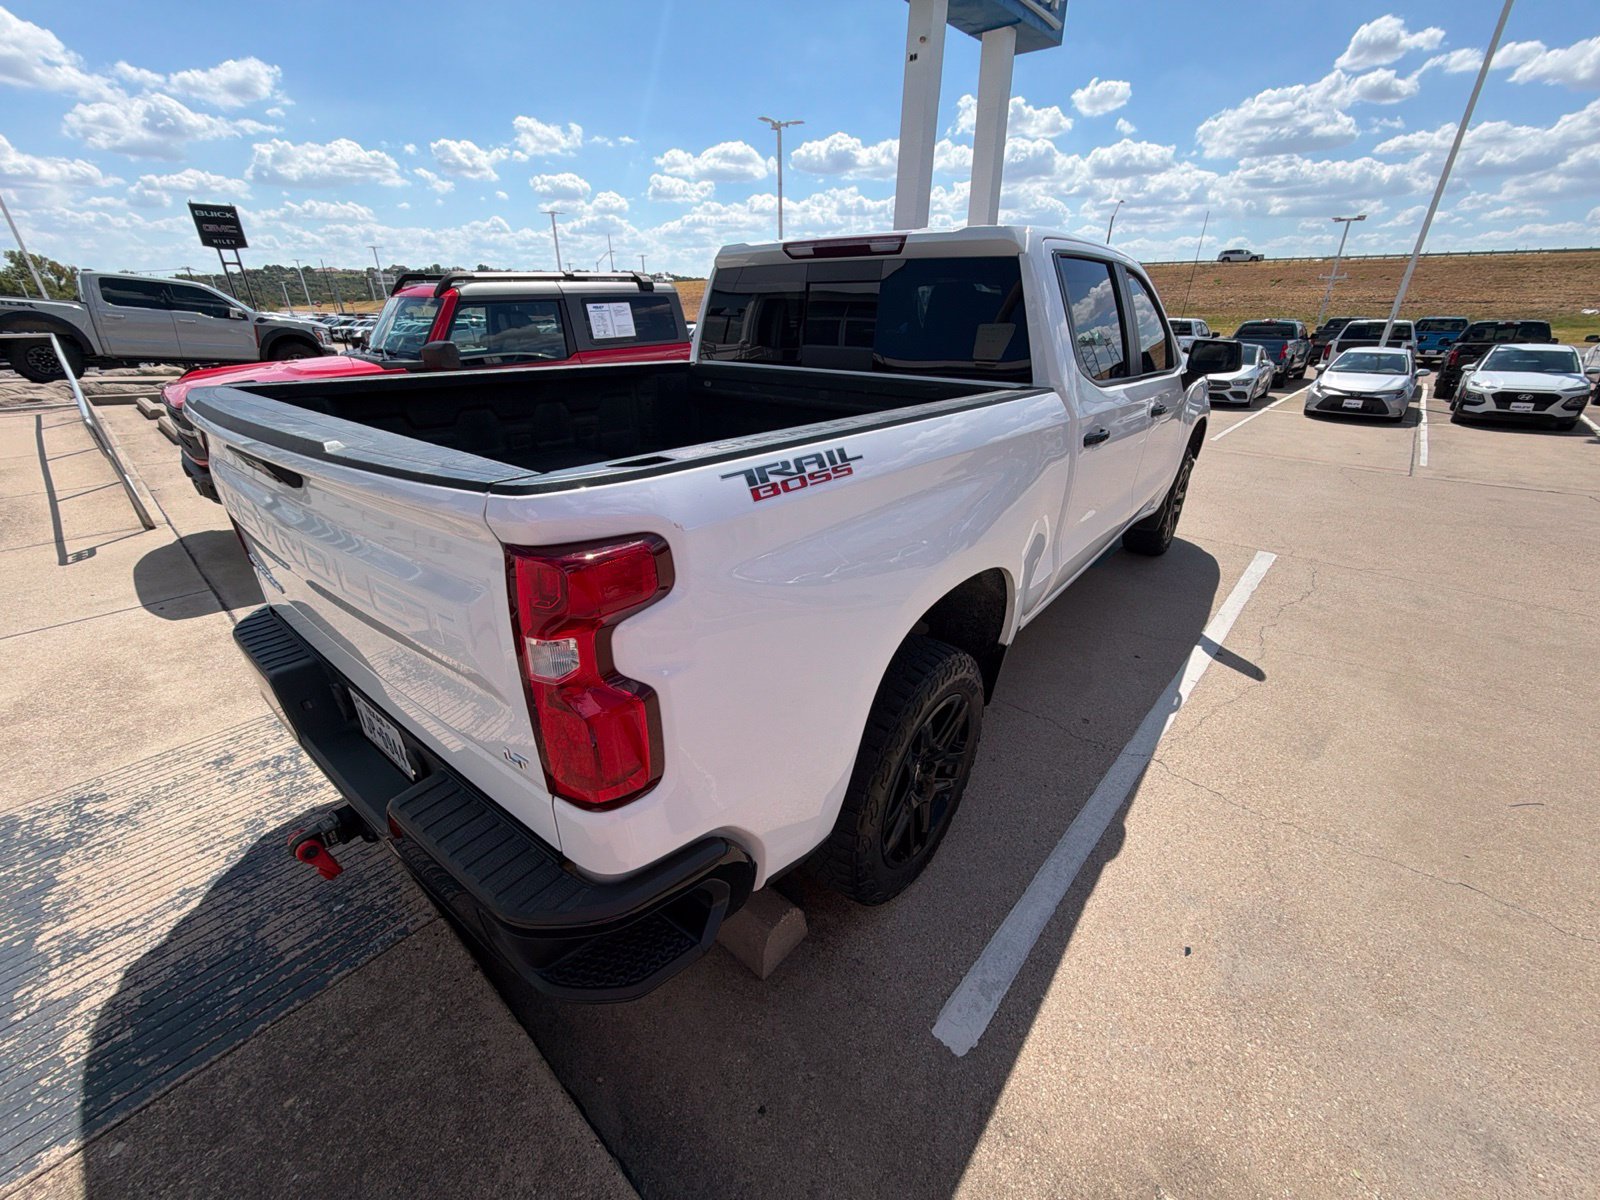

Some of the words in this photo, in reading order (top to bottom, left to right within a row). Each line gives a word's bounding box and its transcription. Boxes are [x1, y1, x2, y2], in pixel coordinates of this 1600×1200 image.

[195, 209, 234, 218] BUICK
[203, 223, 237, 233] GMC
[720, 446, 863, 487] TRAIL
[750, 463, 853, 502] BOSS
[215, 481, 457, 647] HEVROLET
[503, 745, 530, 770] LT
